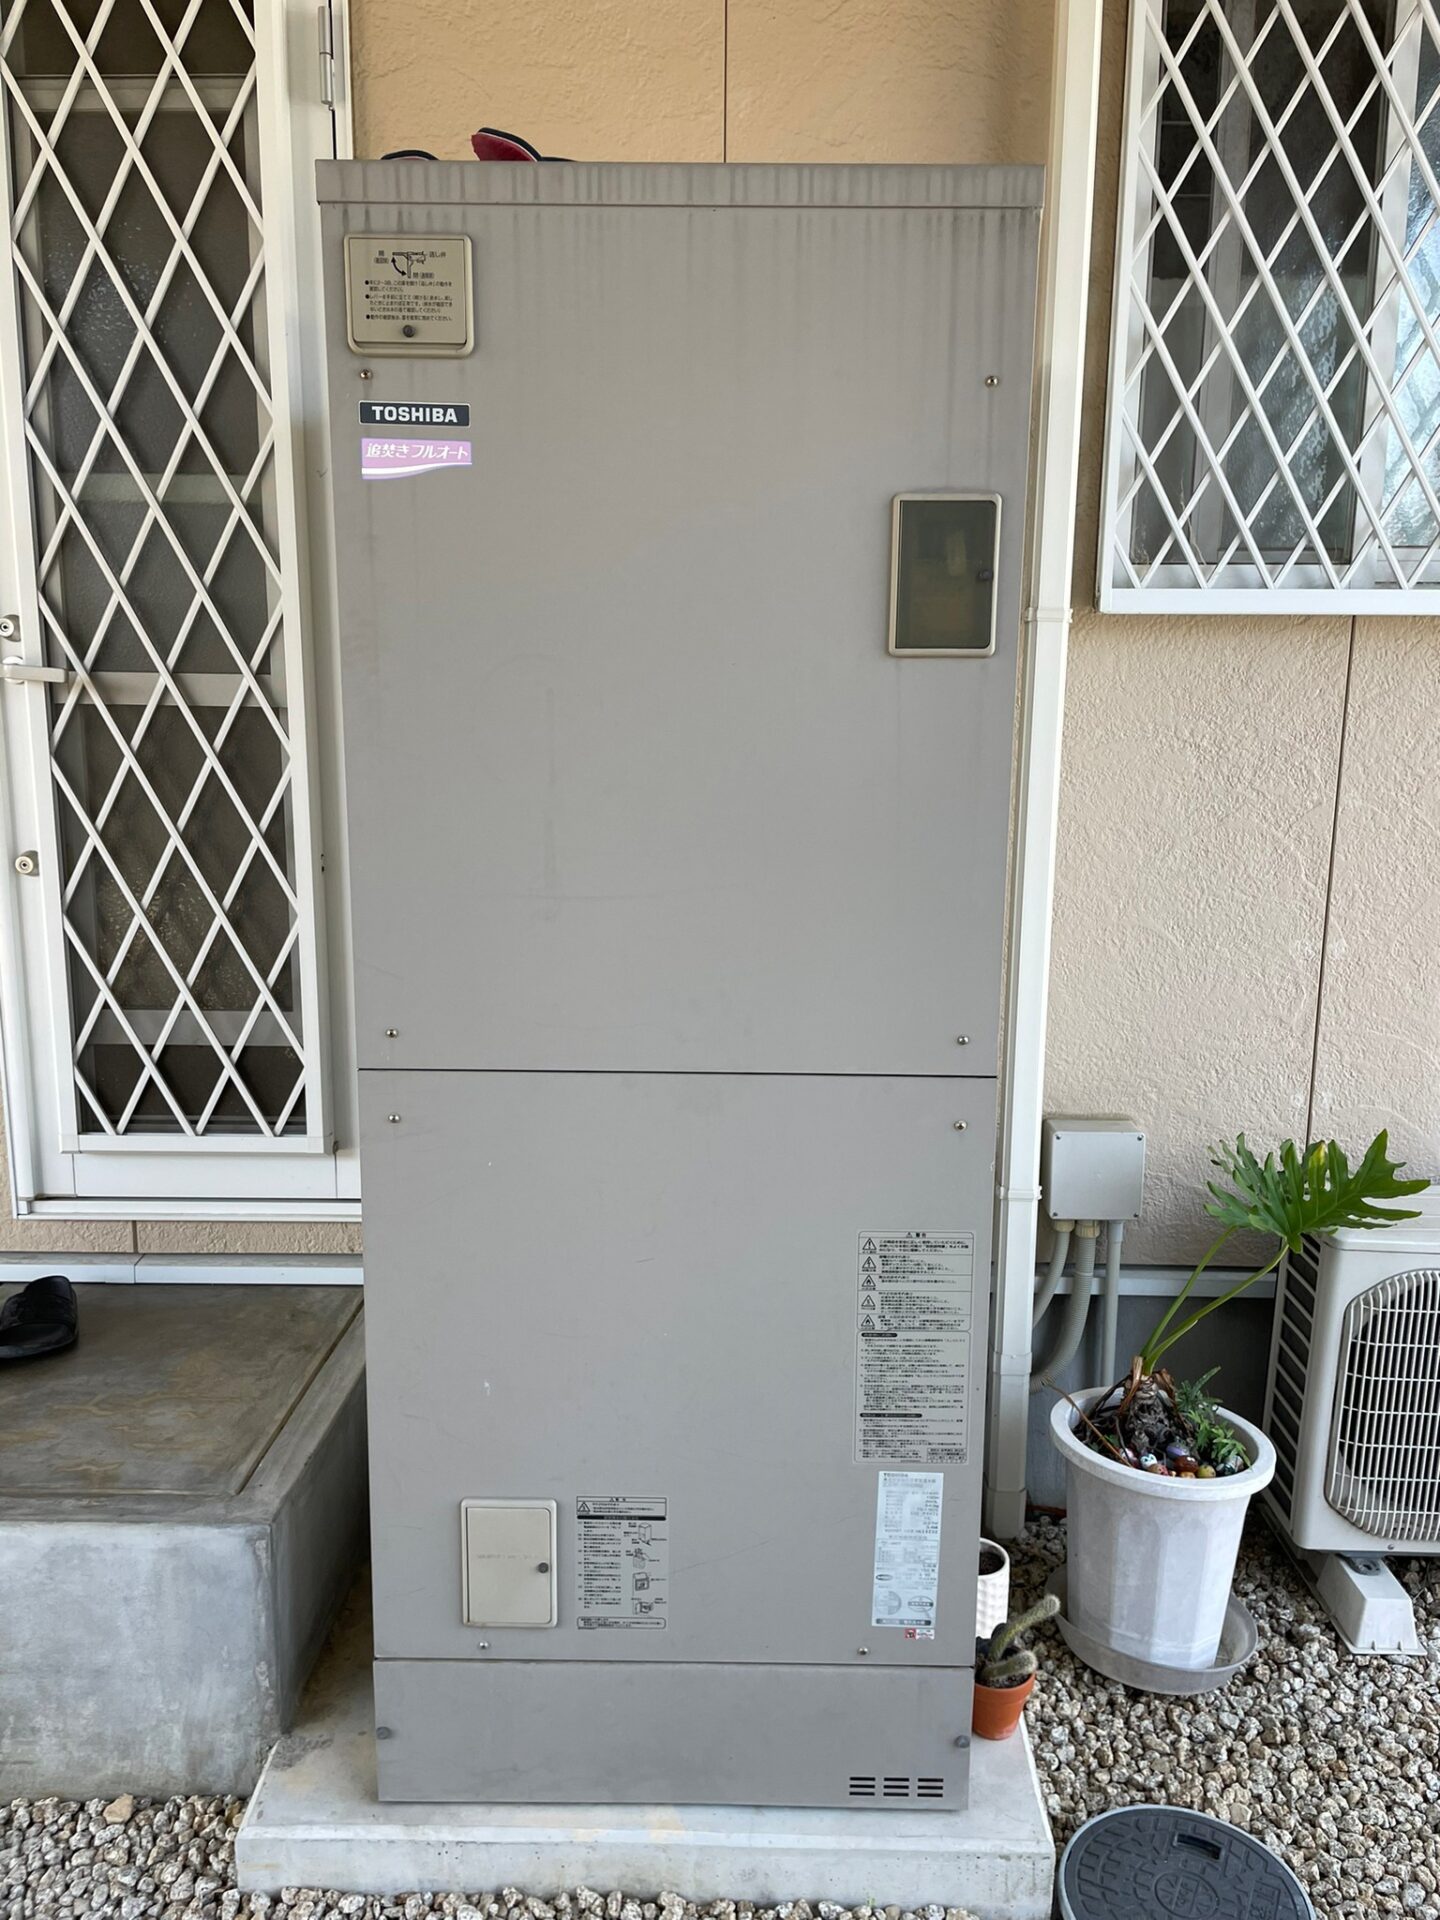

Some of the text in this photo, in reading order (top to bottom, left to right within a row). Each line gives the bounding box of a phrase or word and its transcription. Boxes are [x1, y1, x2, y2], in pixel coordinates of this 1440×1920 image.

[372, 405, 458, 423] TOSHIBA
[366, 443, 468, 460] 追焚きフルオート
